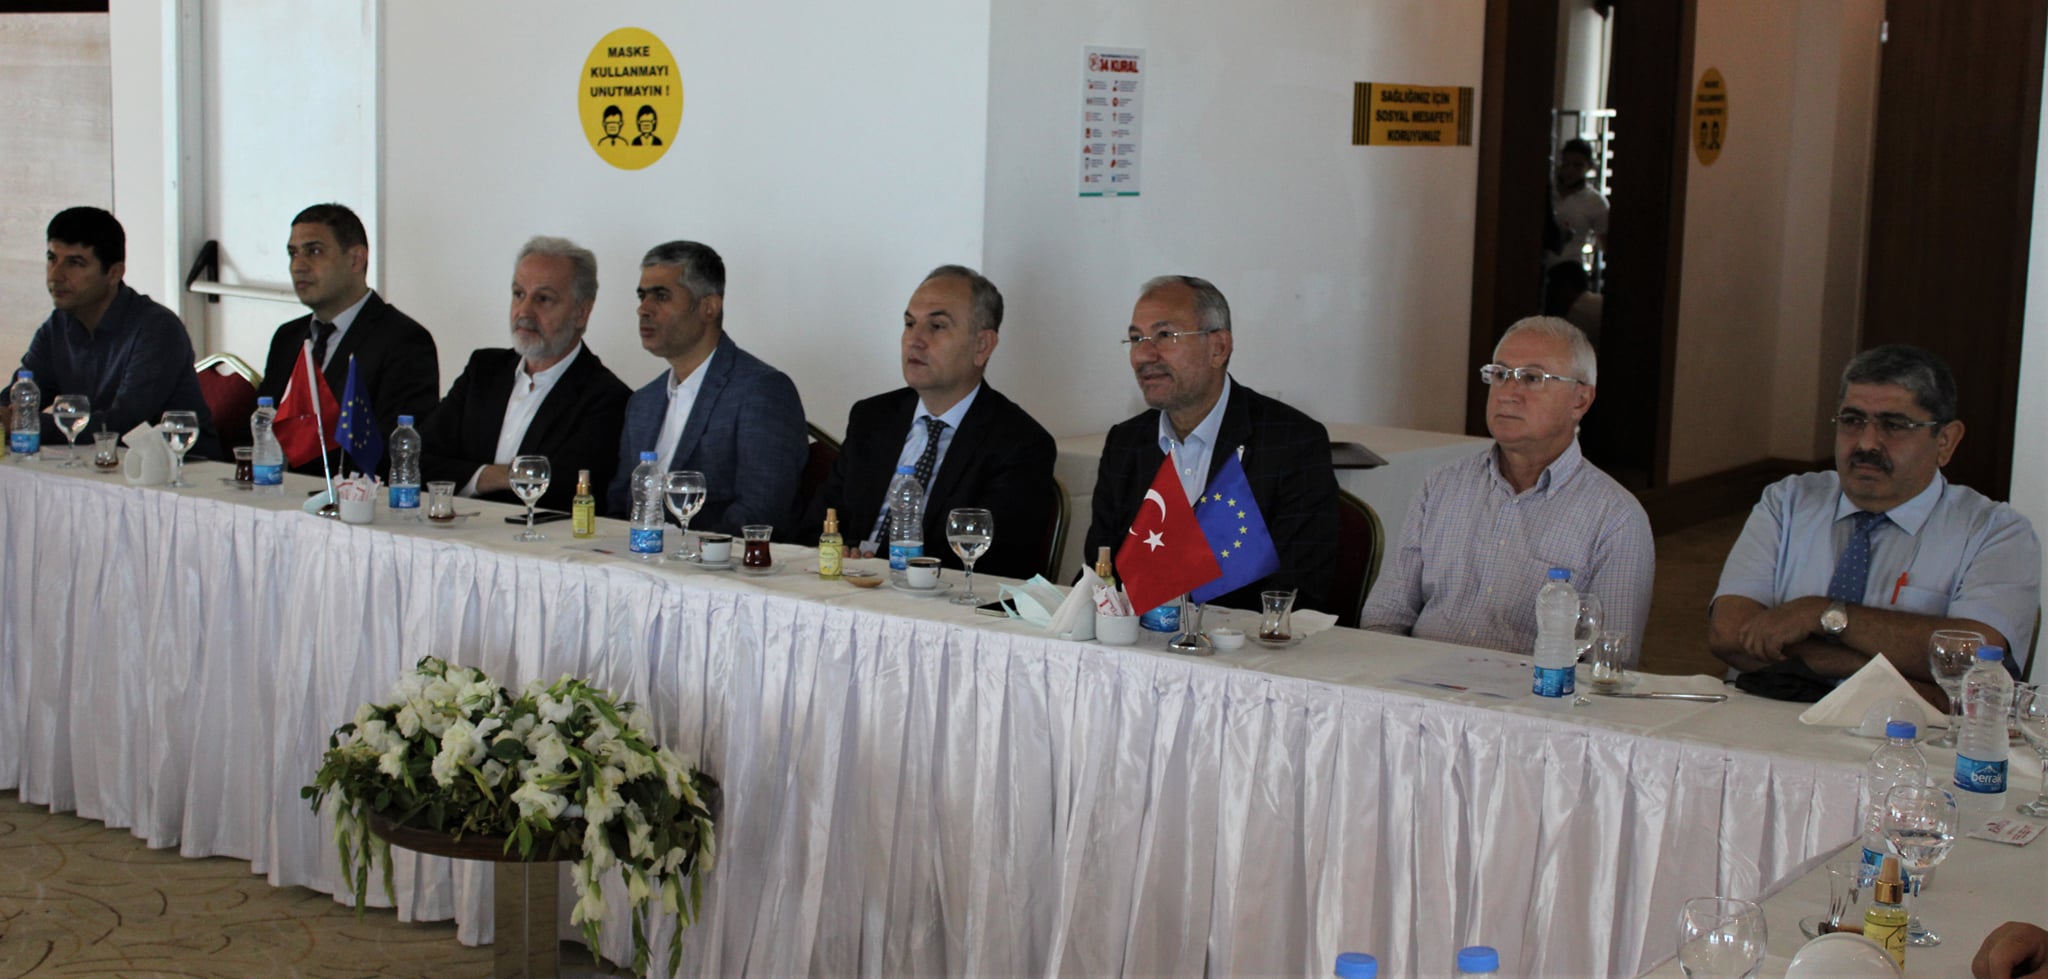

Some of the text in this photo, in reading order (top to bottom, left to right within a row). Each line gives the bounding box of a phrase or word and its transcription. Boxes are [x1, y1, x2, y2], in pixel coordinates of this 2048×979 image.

[608, 46, 650, 57] MASKE
[590, 65, 669, 78] KULLANMAYI
[590, 85, 662, 97] UNUTMAYIN
[1381, 89, 1450, 106] SAĞLIĞINIZ İÇİN
[1376, 110, 1409, 122] SOSYAL
[1387, 129, 1441, 142] KORUYUNUZ
